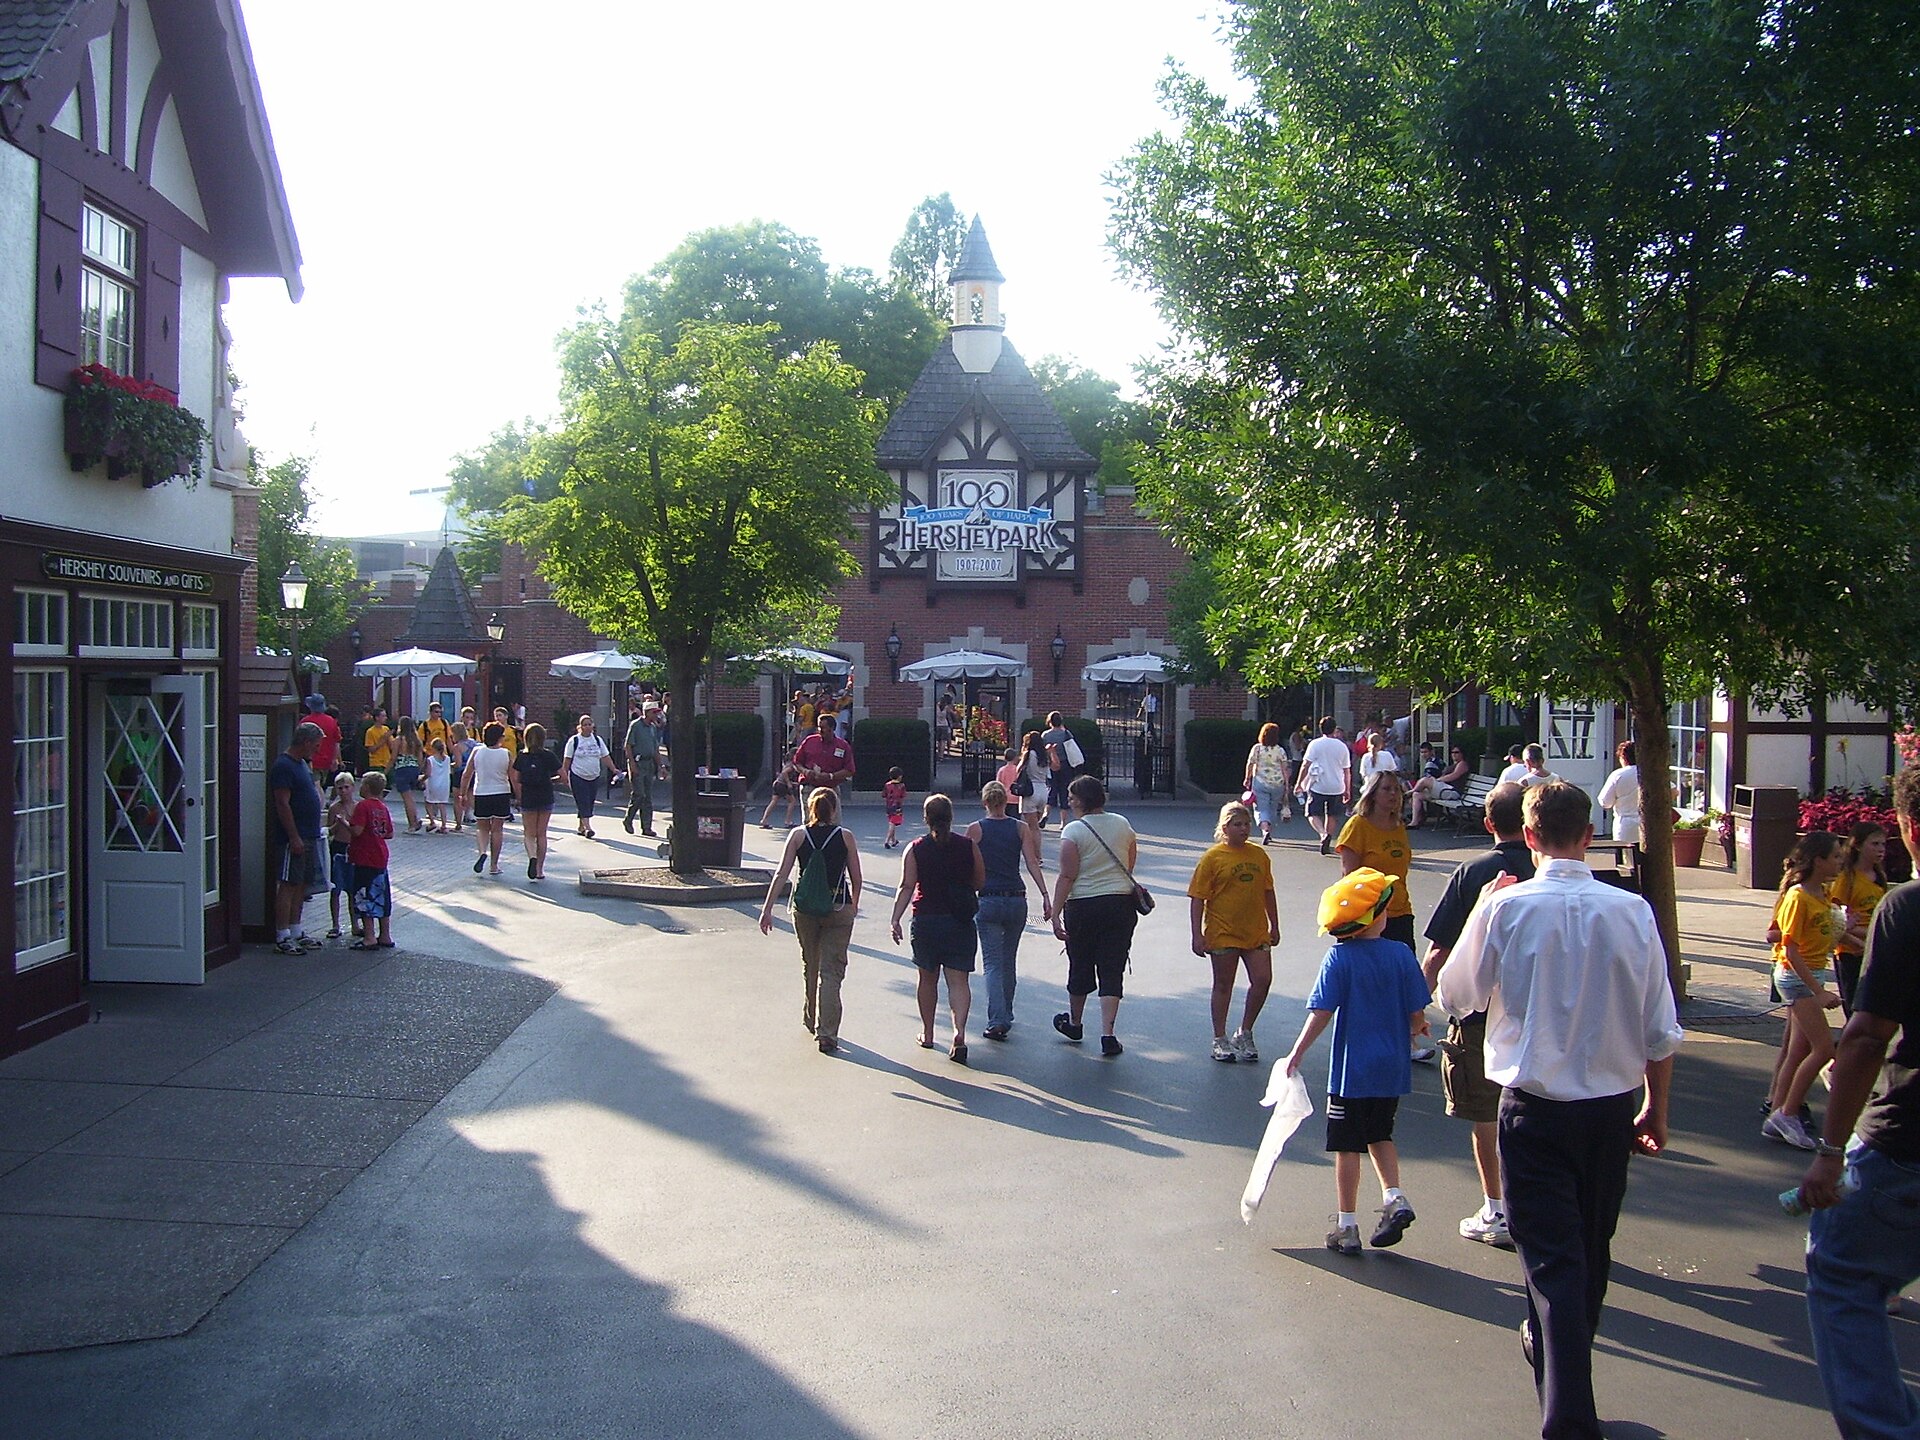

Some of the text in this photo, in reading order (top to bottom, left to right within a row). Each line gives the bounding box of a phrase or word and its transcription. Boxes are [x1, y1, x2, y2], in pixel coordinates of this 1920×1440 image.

[942, 479, 1010, 508] 100
[938, 511, 964, 519] YEARS
[1007, 511, 1033, 523] HAPPY
[899, 520, 1058, 552] HERSHEYPARK
[60, 558, 204, 591] HERSHEY SOUVENIRS AND GIFTS
[239, 738, 264, 748] OUVENIR
